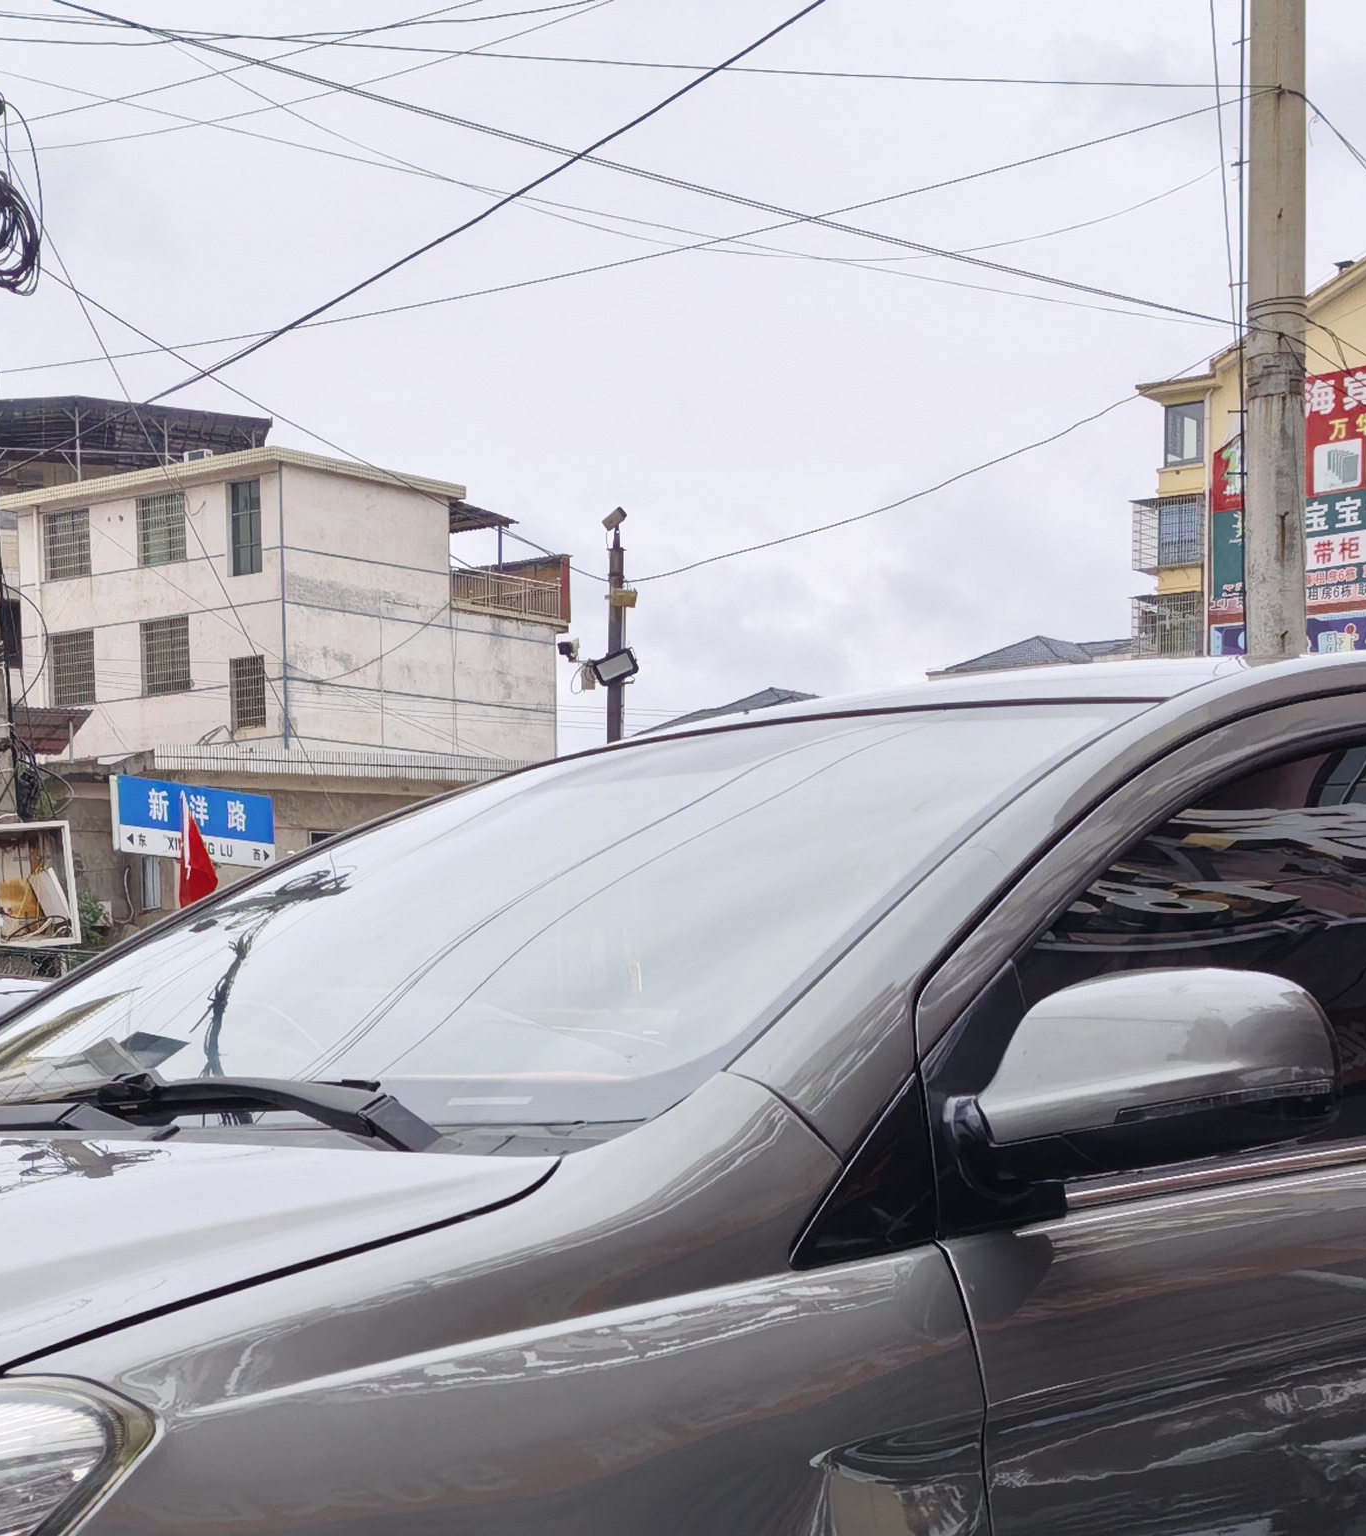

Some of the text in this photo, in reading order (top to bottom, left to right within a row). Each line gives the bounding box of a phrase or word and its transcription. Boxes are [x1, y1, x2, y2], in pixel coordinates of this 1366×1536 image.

[1314, 537, 1360, 564] 带柜
[148, 787, 247, 832] 新洋路
[137, 834, 147, 848] 东
[220, 844, 233, 857] LU
[252, 848, 262, 861] 西
